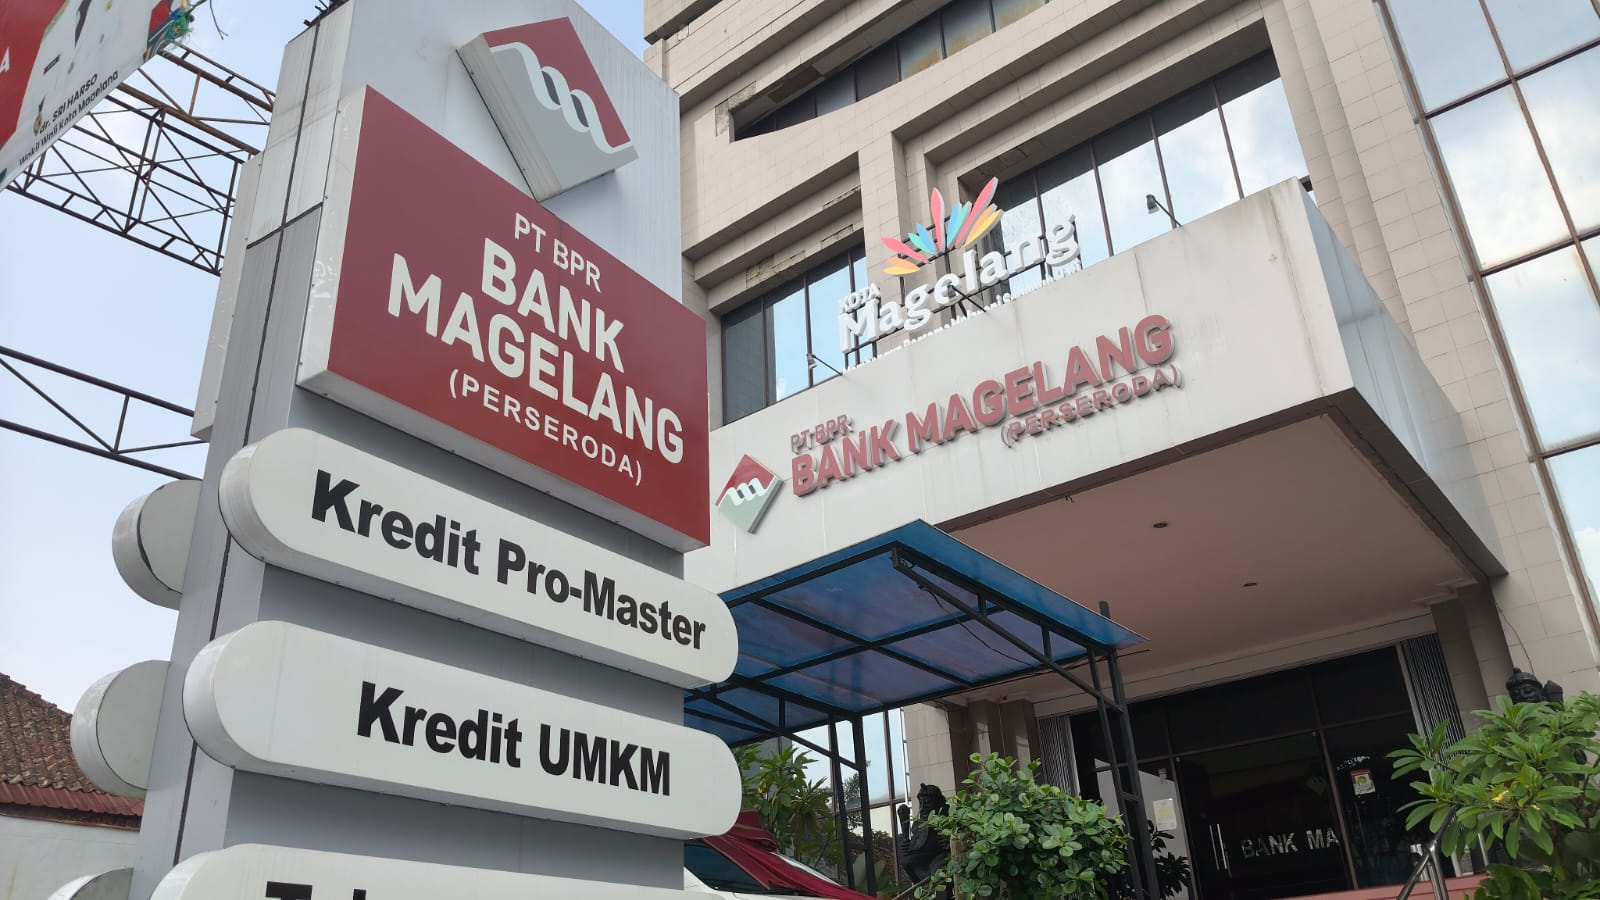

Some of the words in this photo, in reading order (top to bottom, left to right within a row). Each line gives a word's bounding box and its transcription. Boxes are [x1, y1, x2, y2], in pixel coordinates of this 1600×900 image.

[19, 141, 41, 166] Wakil
[41, 124, 58, 147] Wali
[58, 108, 78, 130] Kota
[78, 70, 119, 113] Magelang
[39, 119, 51, 135] dr.
[52, 101, 66, 121] SRI
[66, 73, 98, 109] HARSO
[481, 237, 625, 373] BANK
[514, 212, 547, 253] PT
[552, 237, 602, 294] BPR
[839, 214, 1080, 354] Magelang
[840, 283, 881, 314] KOTA
[387, 252, 684, 465] MAGELANG
[791, 418, 902, 498] BANK
[905, 314, 1176, 454] MAGELANG
[1000, 363, 1184, 448] (PERSERODA)
[448, 368, 643, 487] (PERSERODA)
[790, 429, 816, 455] PT
[815, 414, 855, 446] BPR
[311, 469, 481, 576] Kredit
[496, 539, 707, 650] Pro-Master
[357, 680, 523, 769] Kredit
[538, 724, 671, 798] UMKM
[1241, 832, 1299, 859] BANK
